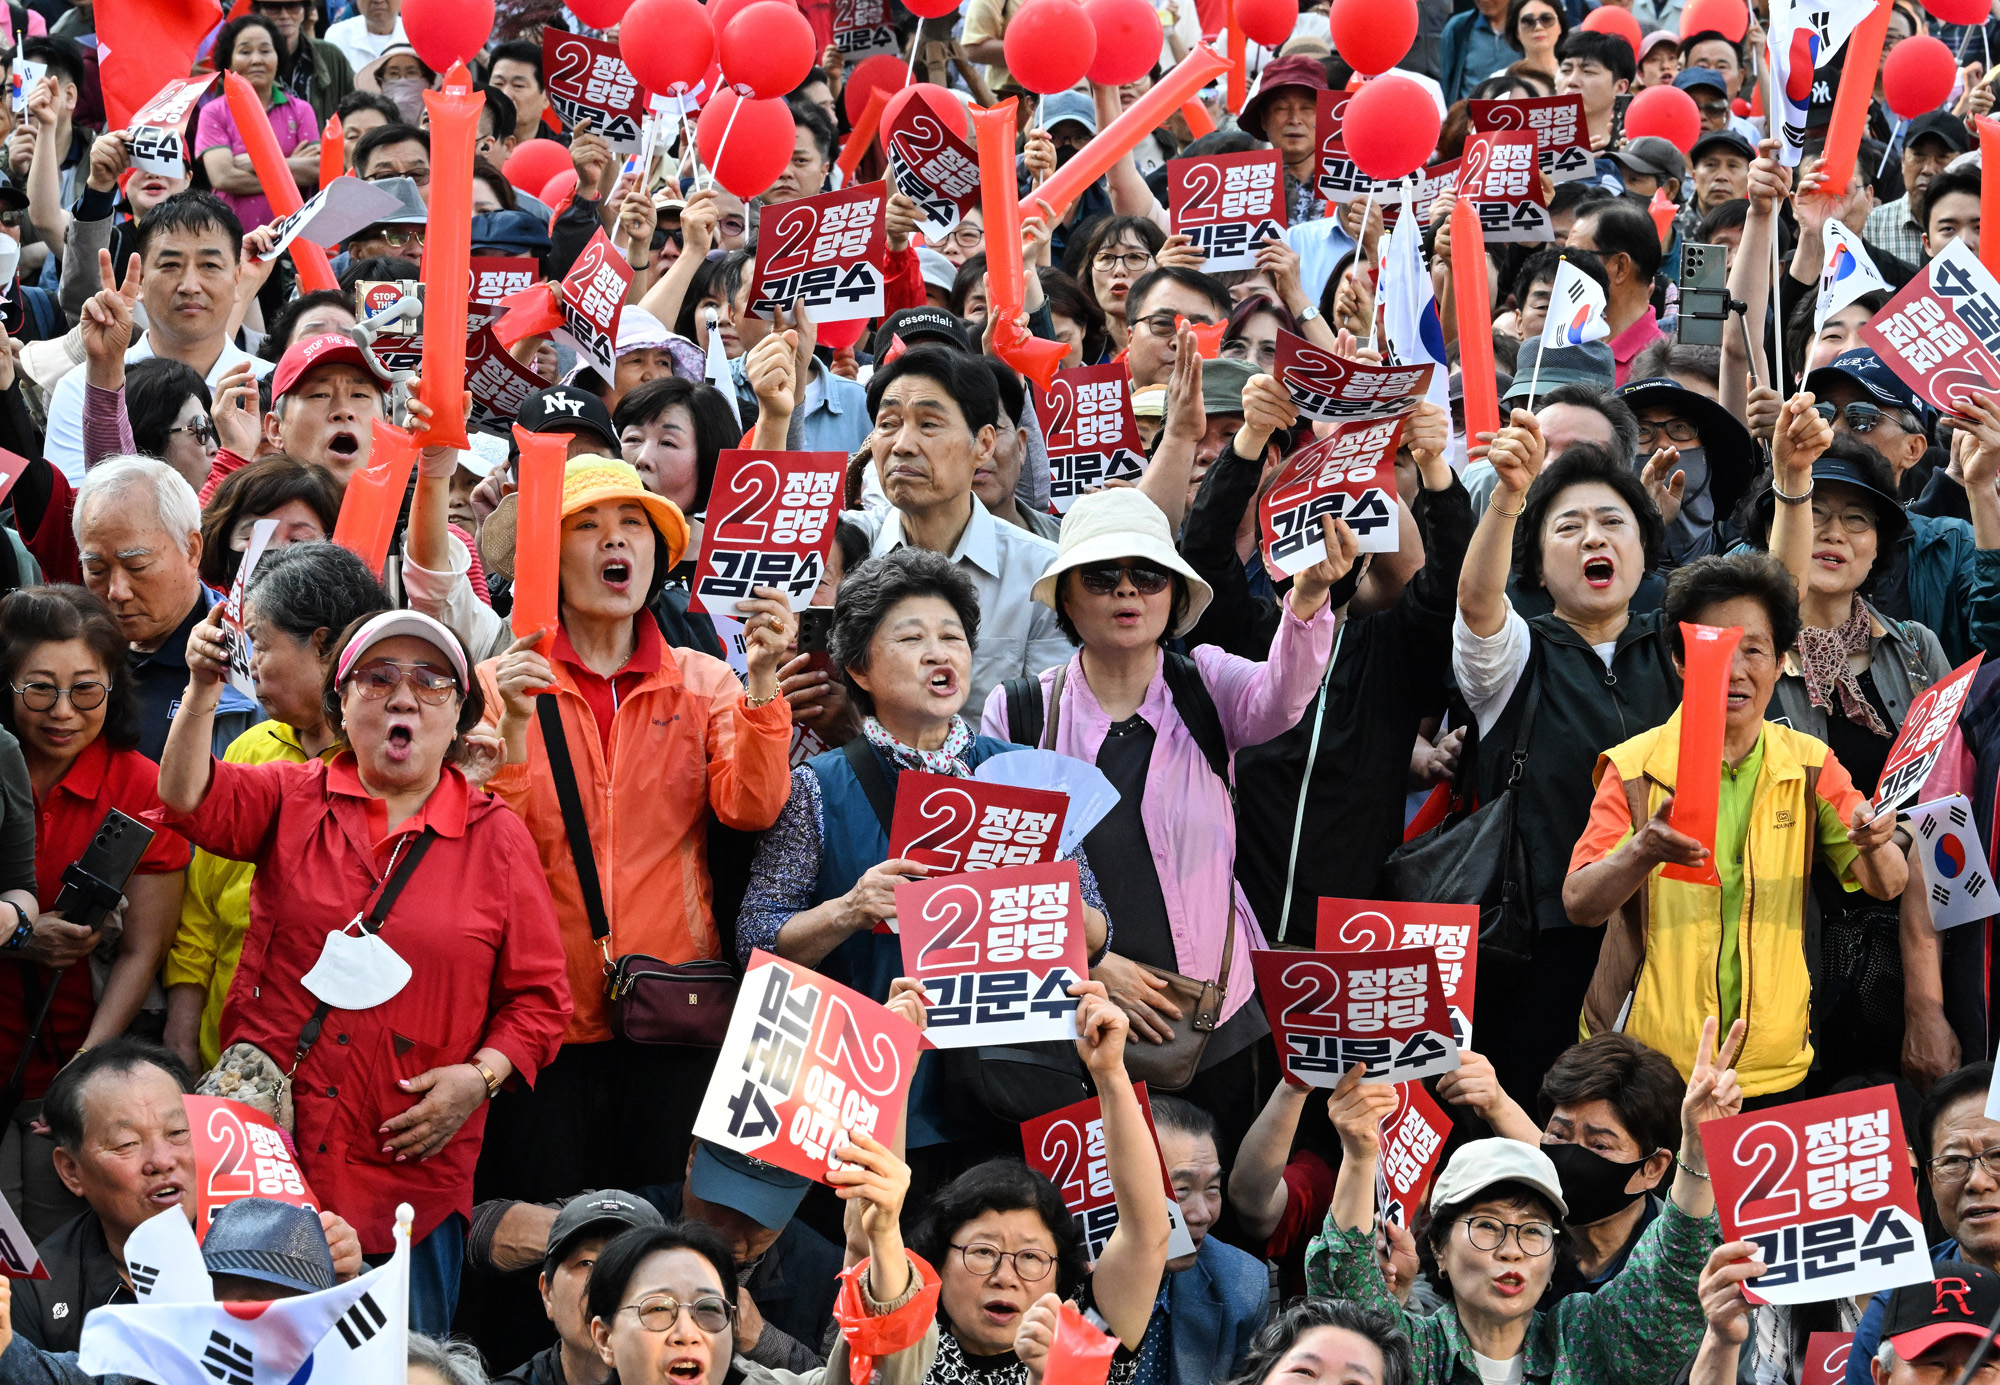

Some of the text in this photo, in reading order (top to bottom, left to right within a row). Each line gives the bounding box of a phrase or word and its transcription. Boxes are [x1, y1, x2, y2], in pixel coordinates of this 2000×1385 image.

[833, 0, 855, 31] 2
[835, 26, 892, 53] 김문수
[549, 41, 591, 98] 2
[586, 79, 635, 110] 당당
[551, 97, 636, 142] 김문수
[1528, 104, 1577, 129] 정정
[894, 115, 943, 165] 2
[1489, 144, 1533, 170] 정정
[1539, 145, 1587, 175] 문수
[920, 158, 973, 198] 당당
[936, 145, 981, 186] 정정
[1224, 162, 1276, 192] 정정
[1458, 139, 1490, 198] 2
[1484, 171, 1531, 197] 당당
[1178, 163, 1221, 223] 2
[1221, 189, 1274, 218] 당당
[819, 198, 880, 235] 정정
[1473, 201, 1544, 232] 문수
[763, 206, 818, 276] 2
[811, 228, 872, 262] 당당
[478, 271, 532, 297] 정정
[561, 242, 604, 303] 2
[593, 261, 628, 305] 정정
[752, 262, 877, 316] 김문수
[376, 301, 394, 309] THE
[467, 313, 495, 332] 정
[581, 285, 615, 329] 당당
[1931, 258, 2000, 362] 문수
[303, 340, 323, 357] STOP
[325, 336, 343, 344] THE
[1875, 312, 1943, 376] 정정
[1902, 296, 1969, 358] 당당
[1283, 349, 1346, 393] 2
[1340, 383, 1416, 399] 당당
[1348, 368, 1424, 389] 정정
[1929, 347, 2000, 413] 2
[543, 391, 585, 418] NY
[1046, 379, 1074, 451] 2
[1076, 379, 1122, 416] 정정
[1283, 378, 1418, 418] 김문수
[1076, 410, 1124, 446] 당당
[1331, 419, 1399, 458] 정정
[781, 471, 840, 507] 정정
[1050, 449, 1143, 497] 김문수
[1269, 437, 1336, 507] 2
[1316, 450, 1385, 488] 당당
[713, 460, 780, 544] 2
[771, 509, 829, 544] 당당
[1271, 489, 1390, 561] 김문수
[698, 549, 822, 598] 김문수
[222, 620, 250, 681] 문수
[1930, 669, 1975, 718] 정정
[1886, 690, 1937, 772] 2
[1915, 703, 1959, 752] 당당
[902, 788, 976, 872] 2
[979, 805, 1057, 845] 정정
[964, 841, 1042, 873] 당당
[990, 882, 1070, 923] 정정
[917, 884, 981, 970] 2
[986, 923, 1068, 963] 당당
[1400, 924, 1471, 960] 정정
[922, 968, 1080, 1025] 김문수
[1281, 961, 1340, 1031] 2
[1347, 964, 1428, 1000] 정정
[1438, 962, 1463, 998] 당
[1347, 996, 1428, 1032] 당당
[727, 965, 820, 1138] 김문수
[815, 994, 900, 1096] 2
[1287, 1030, 1447, 1078] 김문수
[789, 1064, 846, 1161] 당당
[207, 1107, 253, 1197] 2
[249, 1121, 291, 1160] 정정
[1085, 1118, 1106, 1158] 정
[1399, 1105, 1442, 1165] 정정
[1804, 1108, 1891, 1165] 정정
[256, 1158, 305, 1196] 당당
[1041, 1119, 1085, 1208] 2
[1087, 1158, 1115, 1198] 당
[1385, 1136, 1423, 1194] 당당
[1732, 1120, 1800, 1227] 2
[1806, 1156, 1893, 1211] 당당
[1742, 1206, 1915, 1288] 김문수
[1931, 1276, 1976, 1316] R
